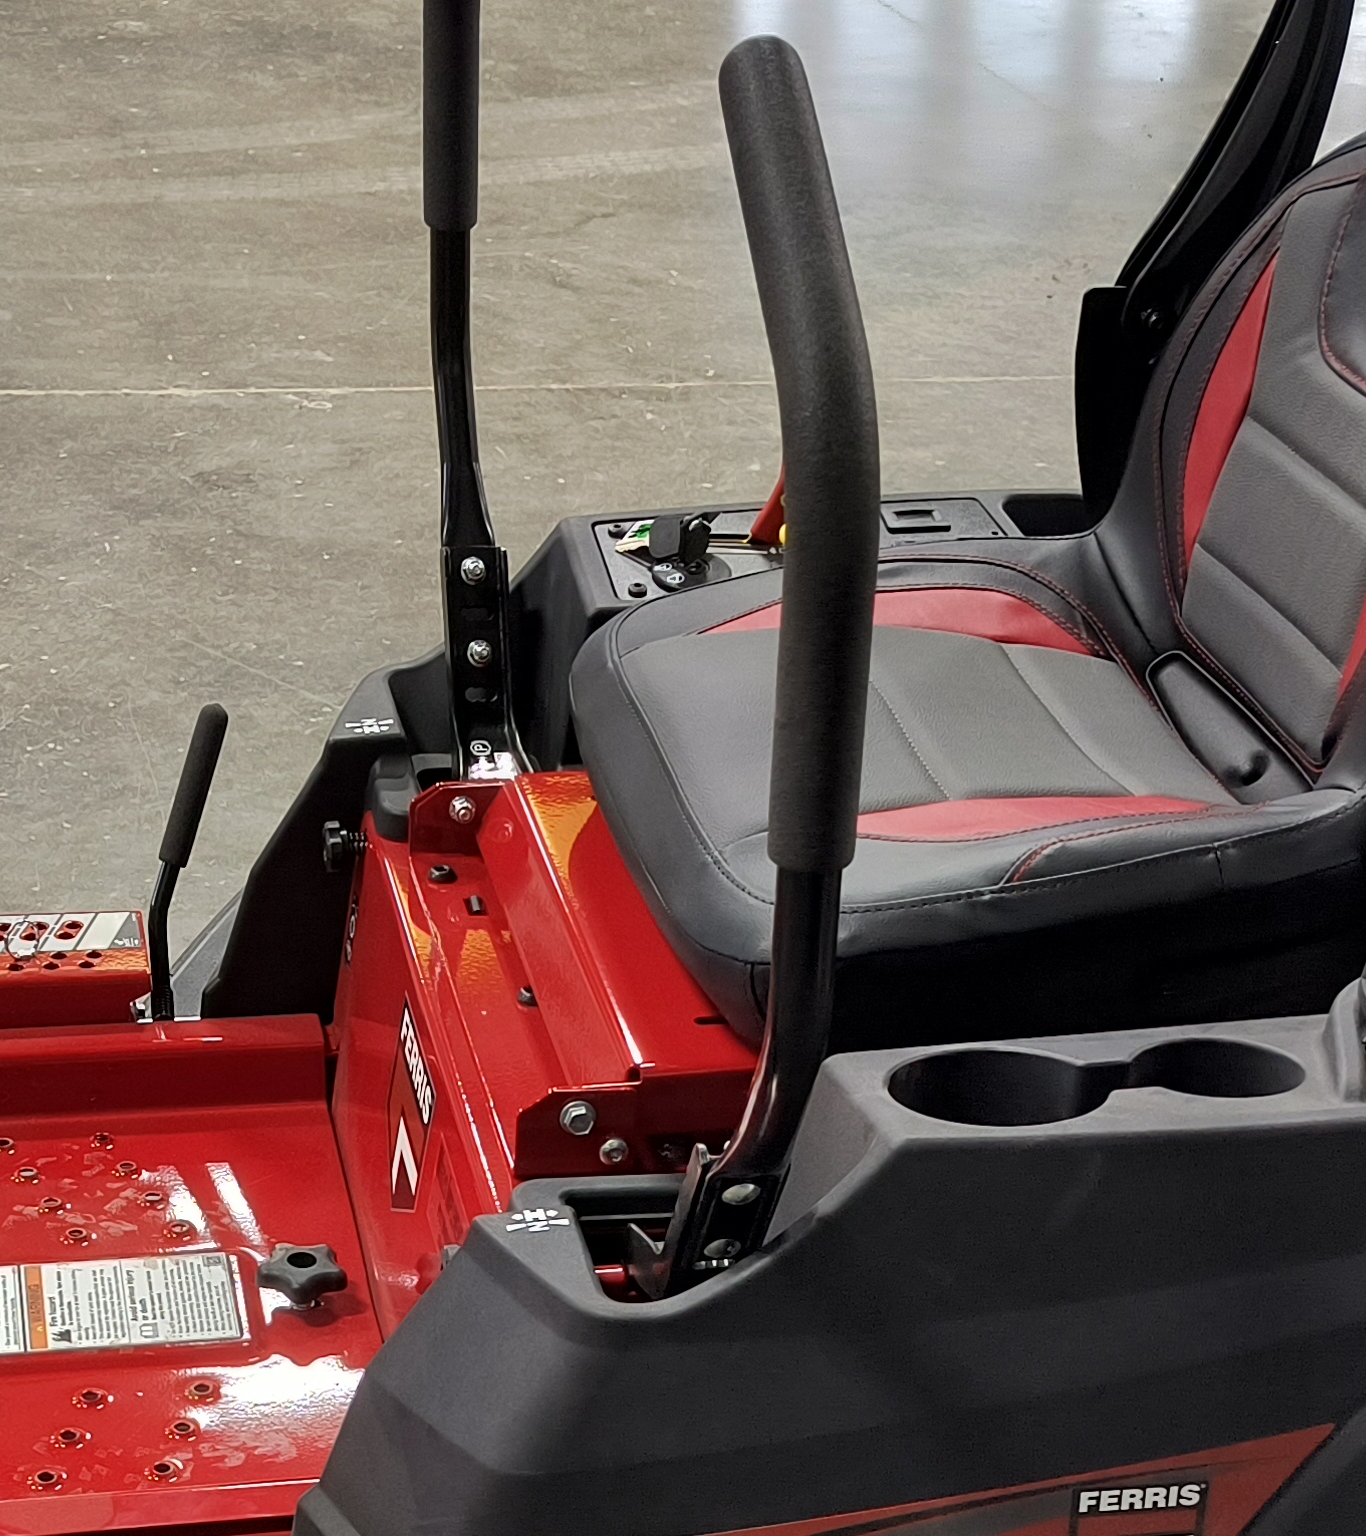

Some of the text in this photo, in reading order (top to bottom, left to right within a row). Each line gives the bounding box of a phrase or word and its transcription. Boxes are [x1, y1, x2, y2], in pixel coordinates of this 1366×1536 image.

[400, 1007, 432, 1125] FERRIS
[28, 1283, 41, 1322] WARNING
[1078, 1484, 1202, 1513] FERRIS
